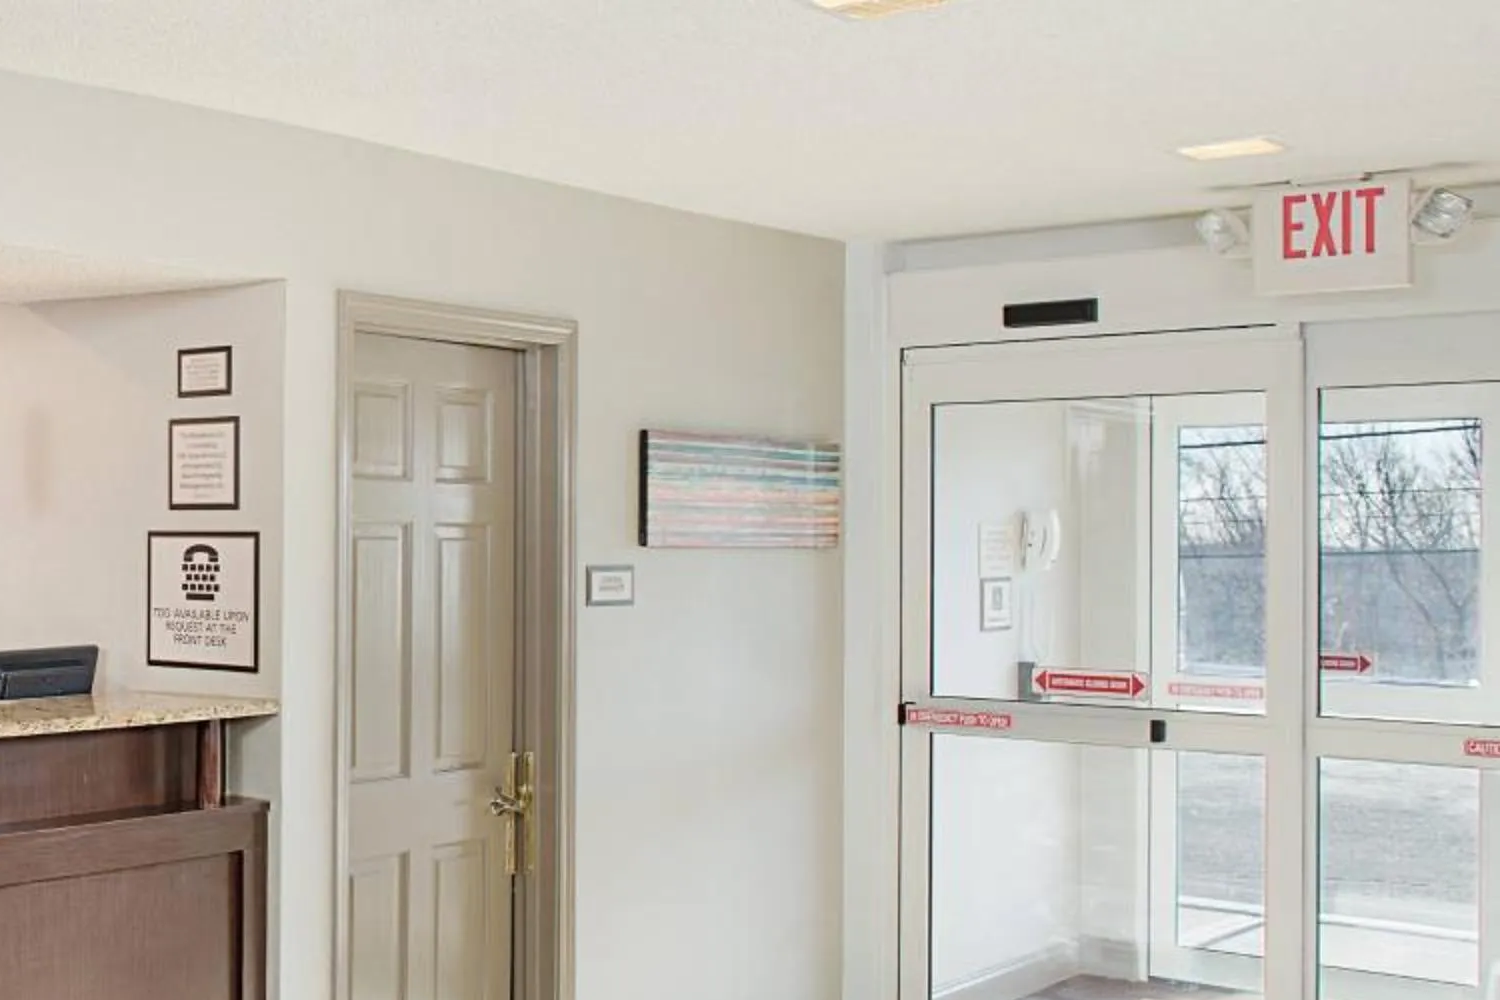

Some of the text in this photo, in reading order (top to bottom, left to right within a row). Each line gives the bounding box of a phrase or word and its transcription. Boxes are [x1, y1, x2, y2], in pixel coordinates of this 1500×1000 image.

[1283, 188, 1385, 259] EXIT
[174, 608, 221, 620] AVAILABLE
[223, 610, 249, 622] UPON
[165, 620, 237, 634] REQUEST AT THE
[173, 633, 227, 647] FRONT DESK
